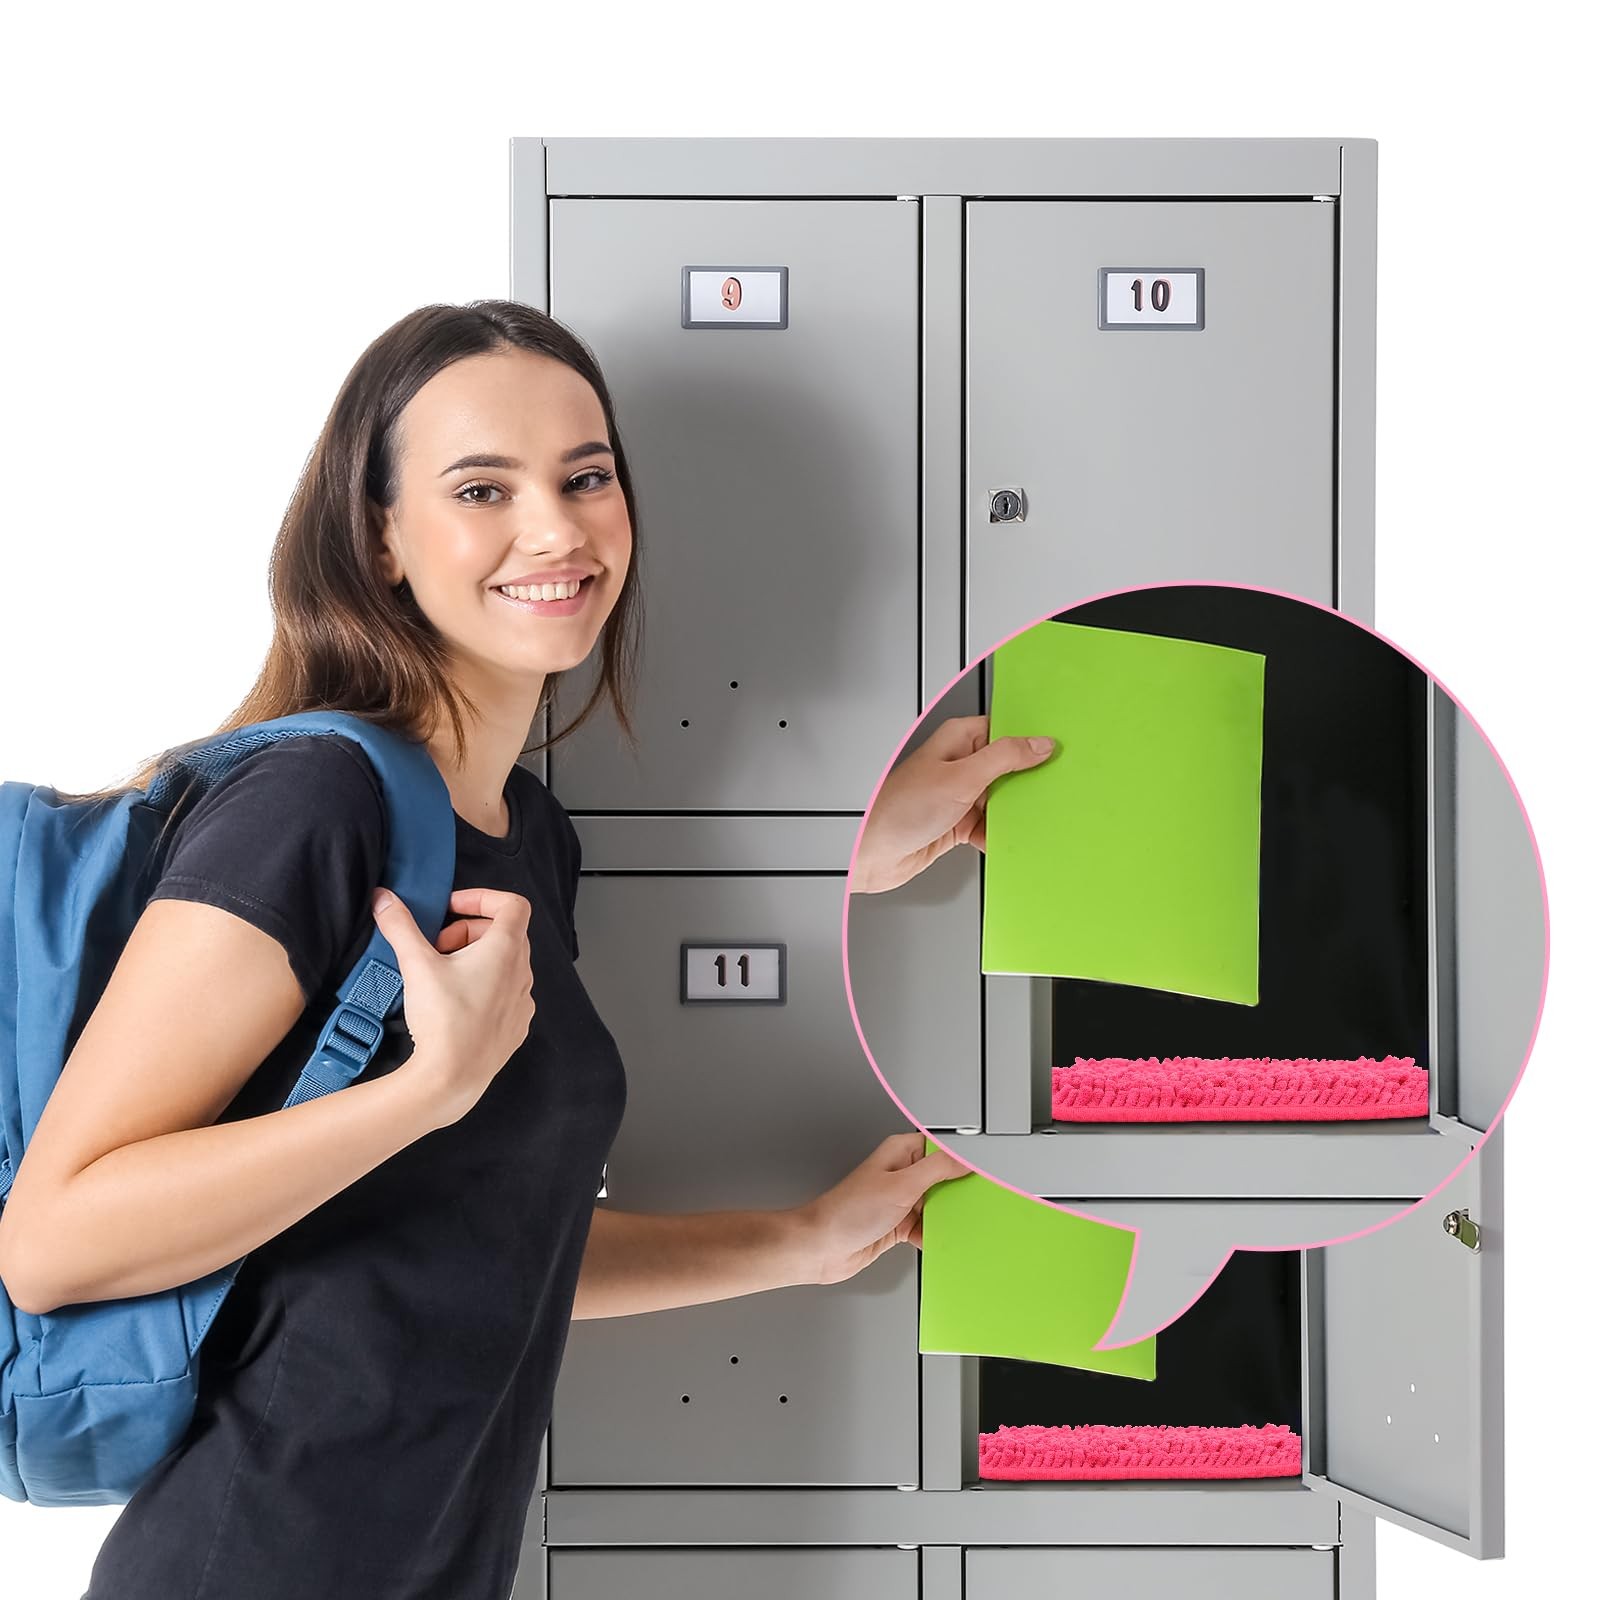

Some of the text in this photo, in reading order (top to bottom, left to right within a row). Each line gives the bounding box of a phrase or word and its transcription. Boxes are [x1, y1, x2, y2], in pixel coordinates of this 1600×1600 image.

[721, 277, 742, 311] 9
[1131, 279, 1171, 312] 10
[714, 954, 750, 987] 11
